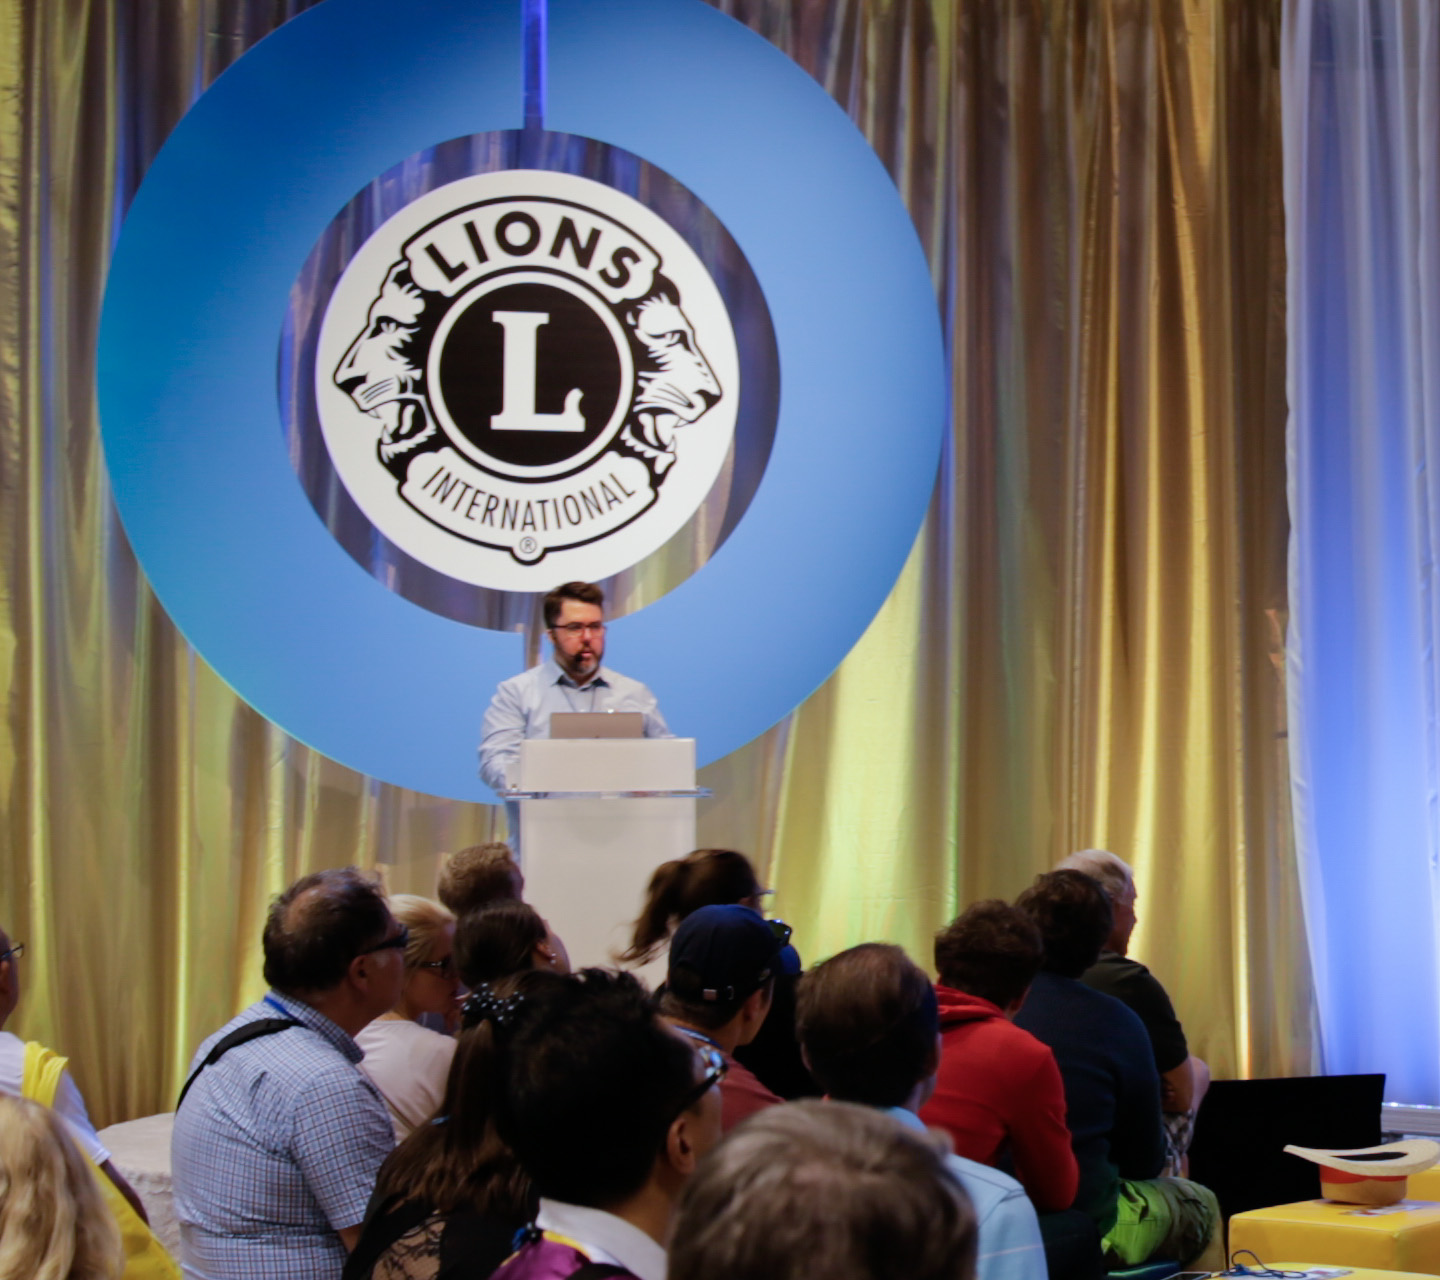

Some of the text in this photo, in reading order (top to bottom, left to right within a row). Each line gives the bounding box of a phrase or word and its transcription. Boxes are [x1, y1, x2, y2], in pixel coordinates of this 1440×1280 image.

[423, 210, 641, 290] LIONS
[489, 310, 587, 433] L
[421, 464, 638, 533] INTERNATIONAL
